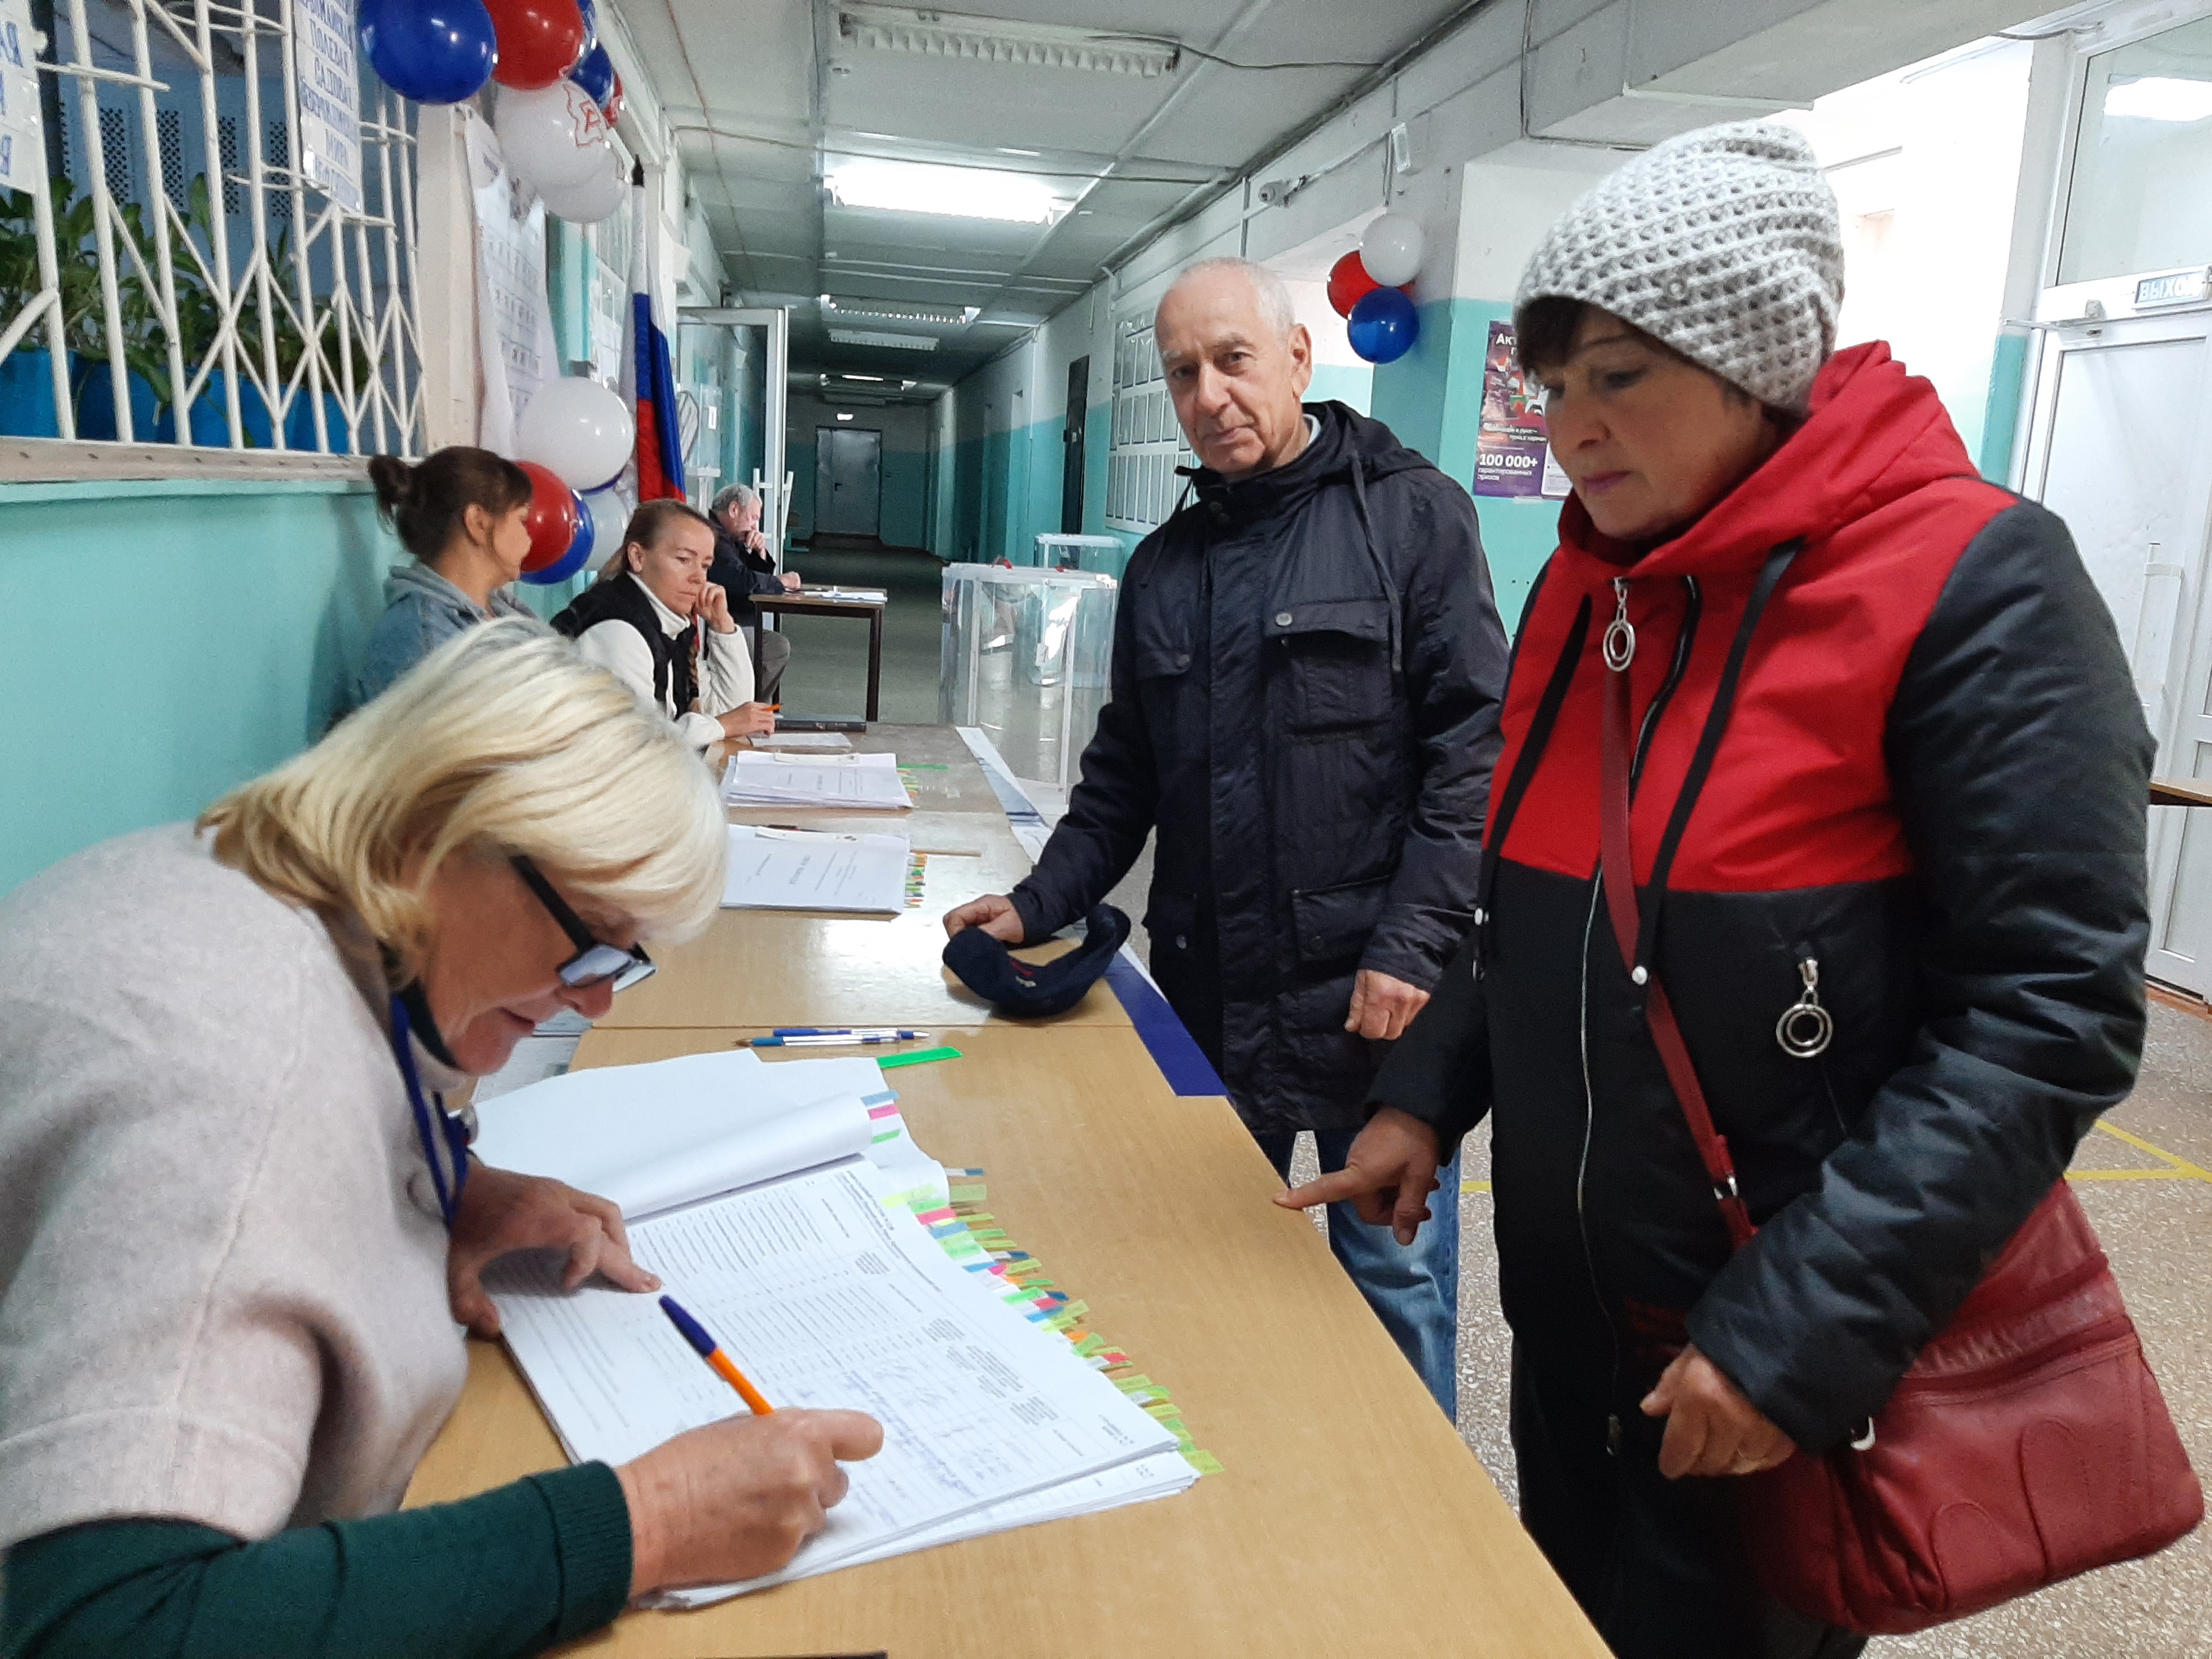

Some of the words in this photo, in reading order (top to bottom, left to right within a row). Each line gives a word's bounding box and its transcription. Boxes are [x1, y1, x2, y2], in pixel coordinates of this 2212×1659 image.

[2139, 275, 2203, 301] ВЫХО
[1480, 454, 1503, 466] 100
[1505, 455, 1538, 468] 000+
